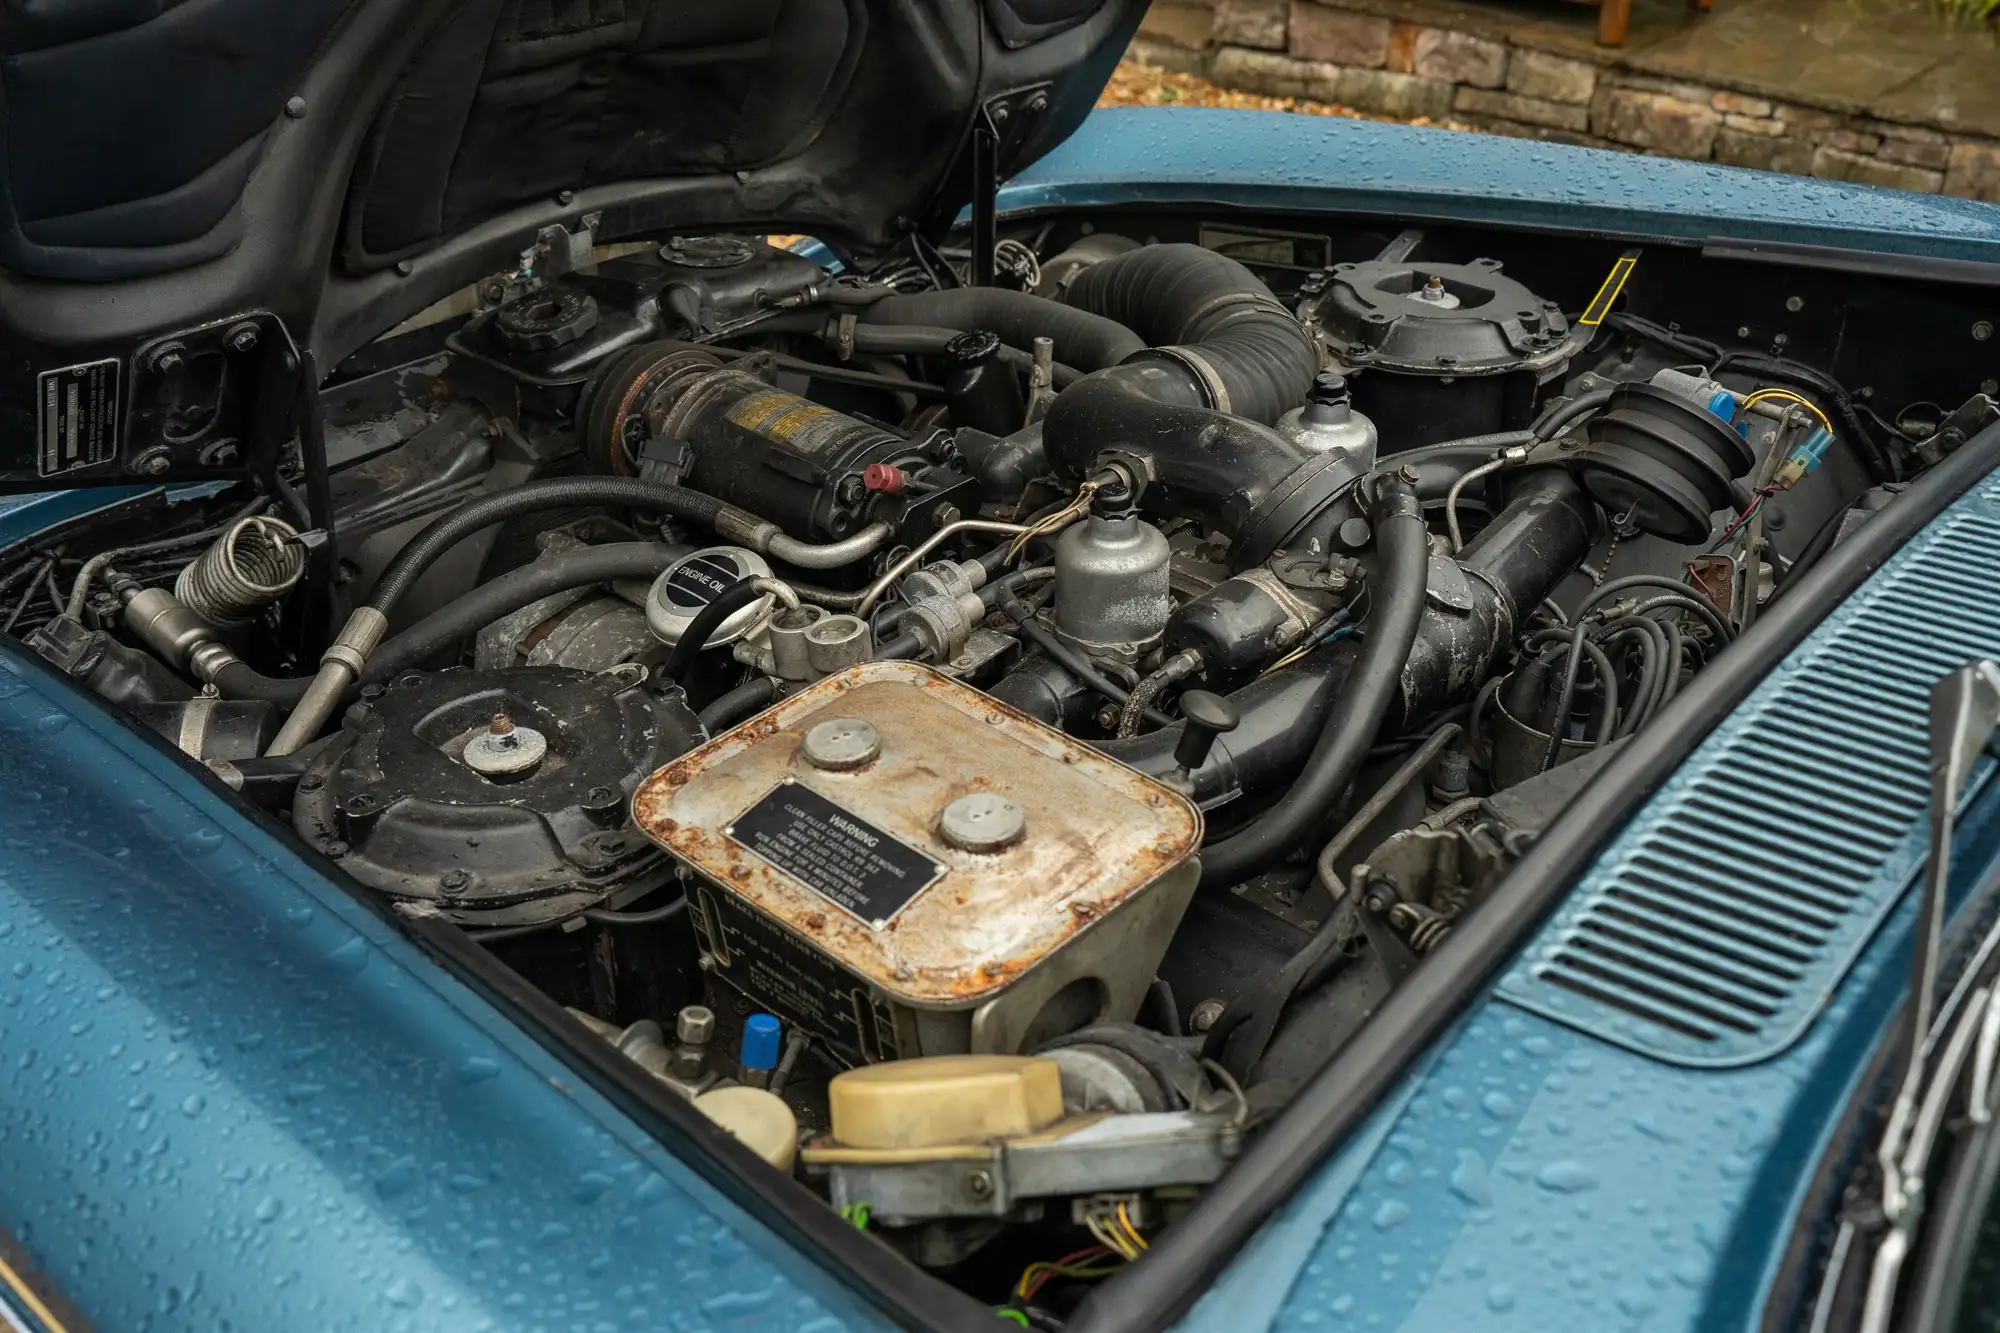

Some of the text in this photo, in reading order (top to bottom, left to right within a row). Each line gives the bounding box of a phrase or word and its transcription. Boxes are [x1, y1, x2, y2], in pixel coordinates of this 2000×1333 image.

[678, 566, 725, 594] ENGINE OIL
[784, 804, 806, 818] CLEAN
[804, 816, 827, 831] FILLER
[826, 828, 845, 841] CAPS
[844, 839, 870, 856] BEFORE
[788, 829, 810, 844] BRAKE
[810, 842, 831, 856] FLUID
[829, 853, 841, 863] TO
[793, 820, 808, 830] USE
[807, 828, 826, 841] ONLY
[825, 839, 853, 859] CASTROL
[829, 814, 879, 847] WARNING
[754, 842, 782, 862] TOPPING
[792, 866, 810, 879] WITH
[809, 877, 824, 888] CAR
[776, 833, 796, 847] FROM
[800, 848, 826, 866] SEALED
[755, 832, 771, 843] RUN
[769, 840, 794, 857] ENGINE
[793, 855, 808, 866] FOR
[813, 867, 844, 888] MINUTES
[842, 886, 870, 905] BEFORE
